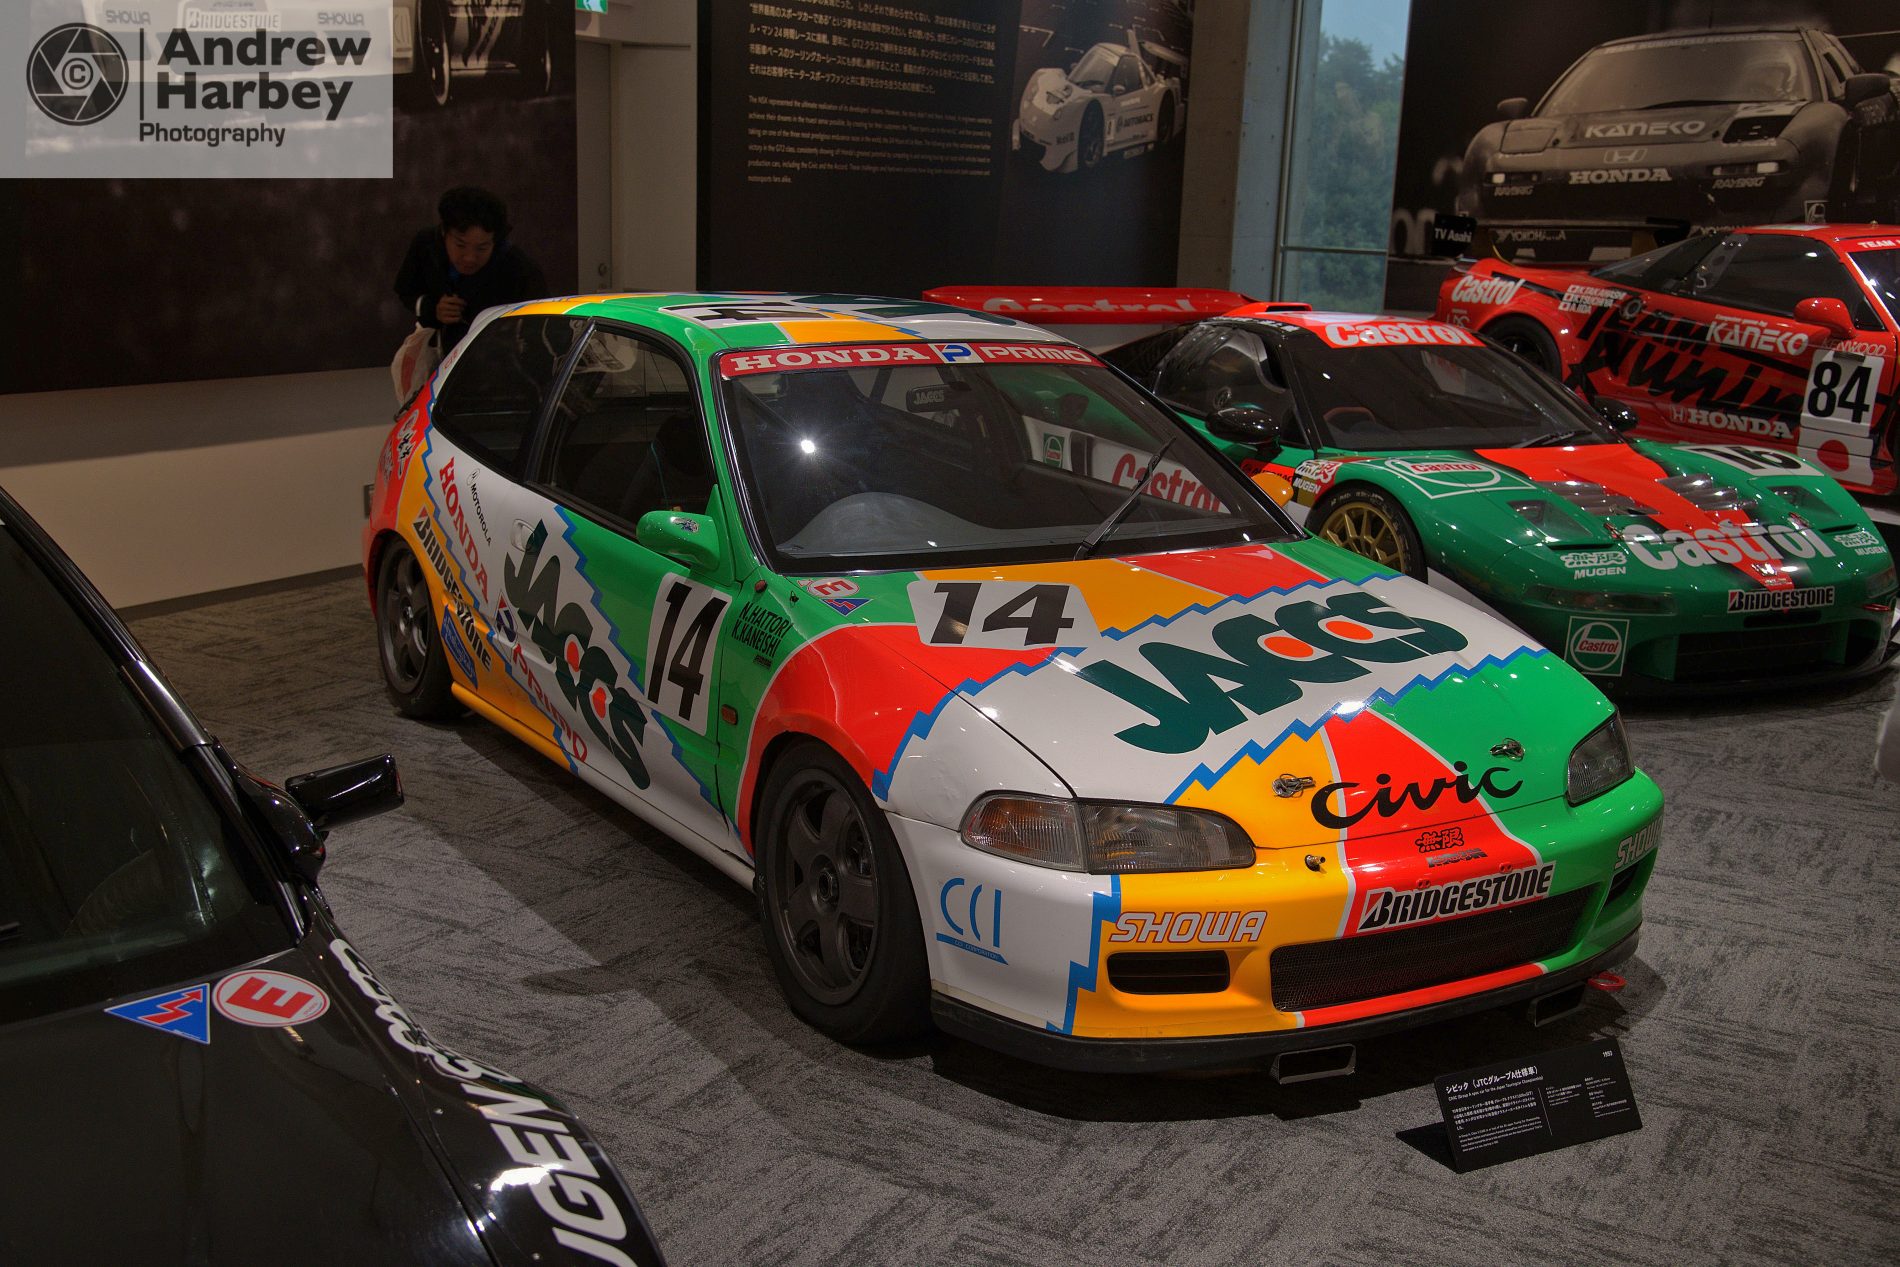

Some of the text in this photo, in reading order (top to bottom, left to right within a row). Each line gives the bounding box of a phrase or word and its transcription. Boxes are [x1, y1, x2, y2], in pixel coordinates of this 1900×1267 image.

[106, 10, 151, 25] SHOWA
[188, 10, 280, 29] BRIDGESTONE
[317, 12, 365, 26] SHOWA
[1585, 120, 1706, 139] KANEKO
[1568, 167, 1673, 185] HONDA
[1434, 227, 1473, 242] TV Asahi
[1857, 240, 1896, 249] TEAM
[1451, 275, 1526, 304] Castrol
[1325, 322, 1475, 346] Castrol
[1706, 321, 1809, 356] KANEKO
[1821, 338, 1887, 356] KENWOOD
[732, 347, 931, 372] HONDA
[983, 346, 1093, 363] PRIMO
[1807, 360, 1873, 424] 84
[1686, 408, 1794, 439] HONDA
[1410, 462, 1482, 473] Castrol
[1293, 477, 1322, 495] MUGEN
[471, 482, 493, 547] MOTOROLA
[439, 457, 488, 603] HONDA
[1624, 518, 1835, 570] Castrol
[1573, 566, 1626, 580] MUGEN
[413, 513, 492, 671] BRIDGESTONE
[1729, 587, 1834, 611] BRIDGESTONE
[929, 582, 1072, 647] 14
[502, 519, 652, 791] JACCS
[648, 582, 728, 721] 14
[1577, 639, 1619, 653] Castrol
[1073, 591, 1469, 754] JACCS
[1310, 761, 1525, 829] civic
[1363, 864, 1554, 931] BRIDGESTONE
[940, 877, 1002, 948] CCI
[1108, 911, 1268, 944] SHOWA
